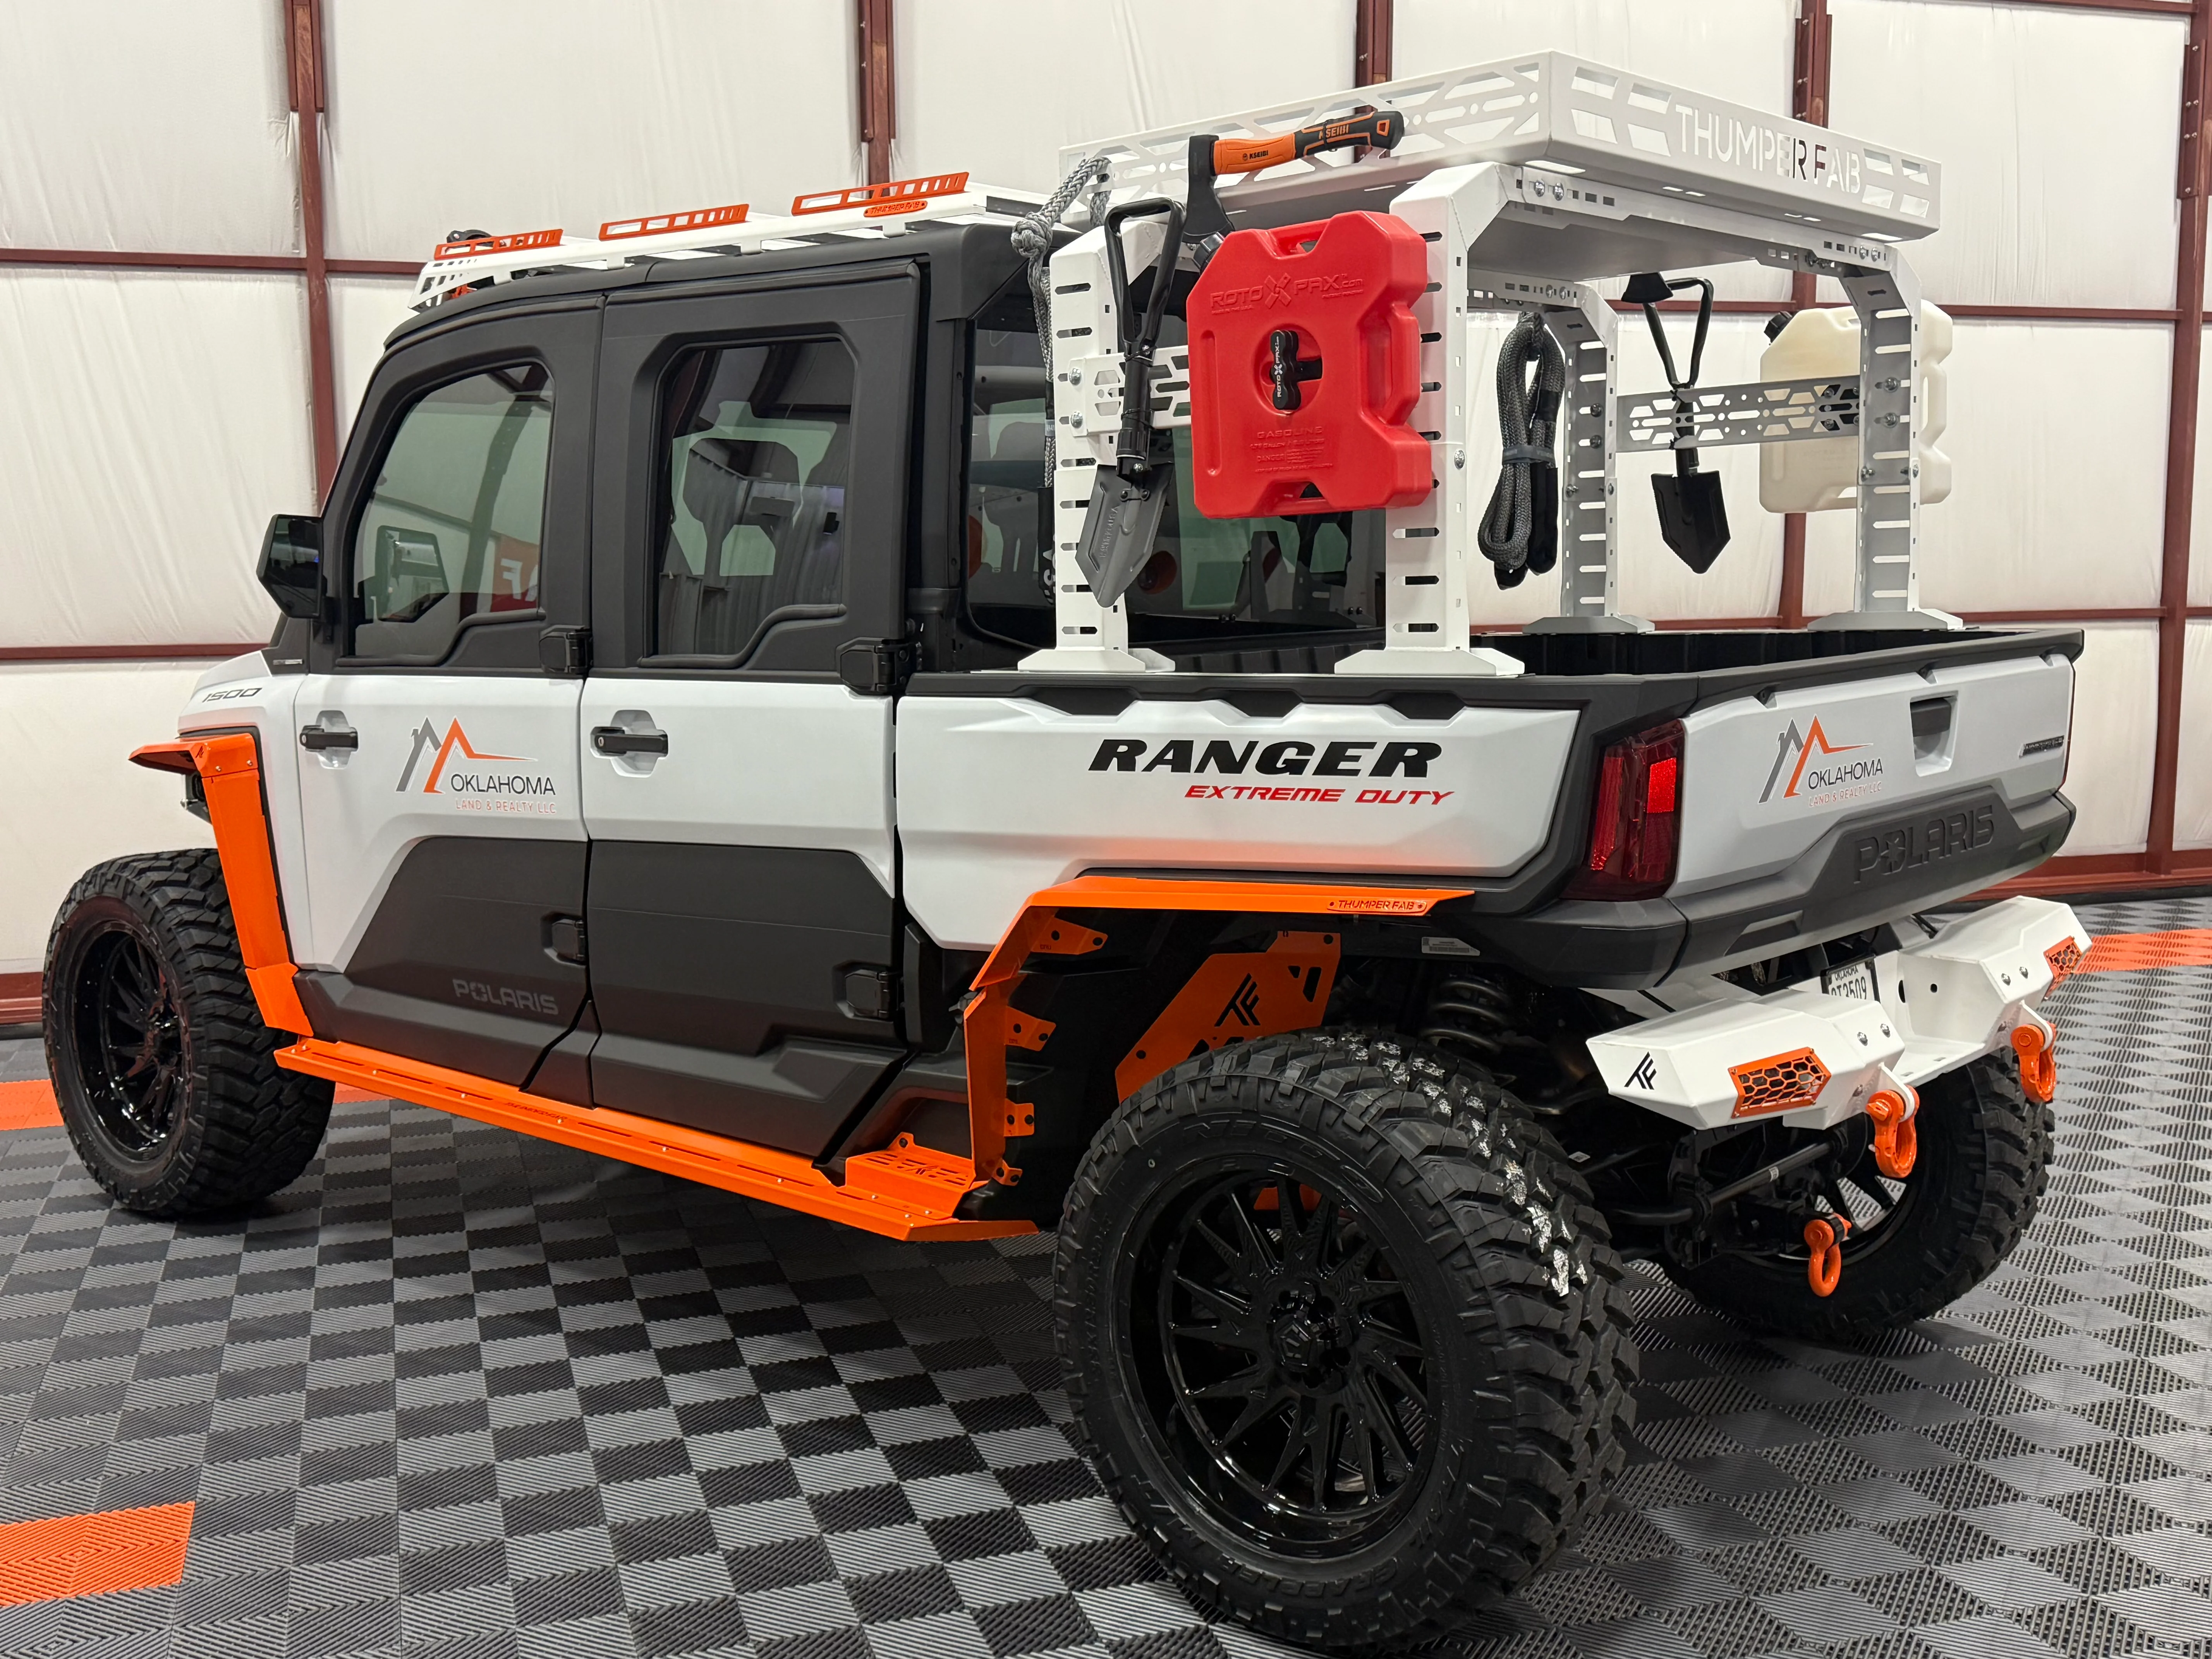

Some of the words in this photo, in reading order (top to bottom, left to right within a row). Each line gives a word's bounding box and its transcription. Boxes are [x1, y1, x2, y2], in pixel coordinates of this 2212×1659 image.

[1675, 103, 1808, 182] THUMPER
[1814, 144, 1860, 194] FAB
[1210, 285, 1263, 307] ROTO
[1257, 426, 1323, 438] GASOLINE
[202, 687, 263, 703] 1500
[1088, 738, 1443, 778] RANGER
[451, 773, 556, 795] OKLAHOMA
[1808, 758, 1883, 790] OKLAHOMA
[1184, 785, 1346, 802] EXTREME
[1354, 789, 1455, 805] DUTY
[1809, 793, 1830, 807] LAND
[1832, 791, 1837, 803] &
[1839, 785, 1868, 801] REALTY
[1870, 781, 1882, 793] LLC
[455, 799, 482, 810] LAND
[486, 800, 492, 811] &
[496, 800, 534, 812] REALTY
[538, 802, 556, 814] LLC
[1854, 804, 1994, 885] POLARIS
[1338, 900, 1390, 910] THUMPER
[1392, 901, 1415, 910] FAB
[1834, 965, 1859, 982] OKLAHOMA
[452, 979, 559, 1016] POLARIS
